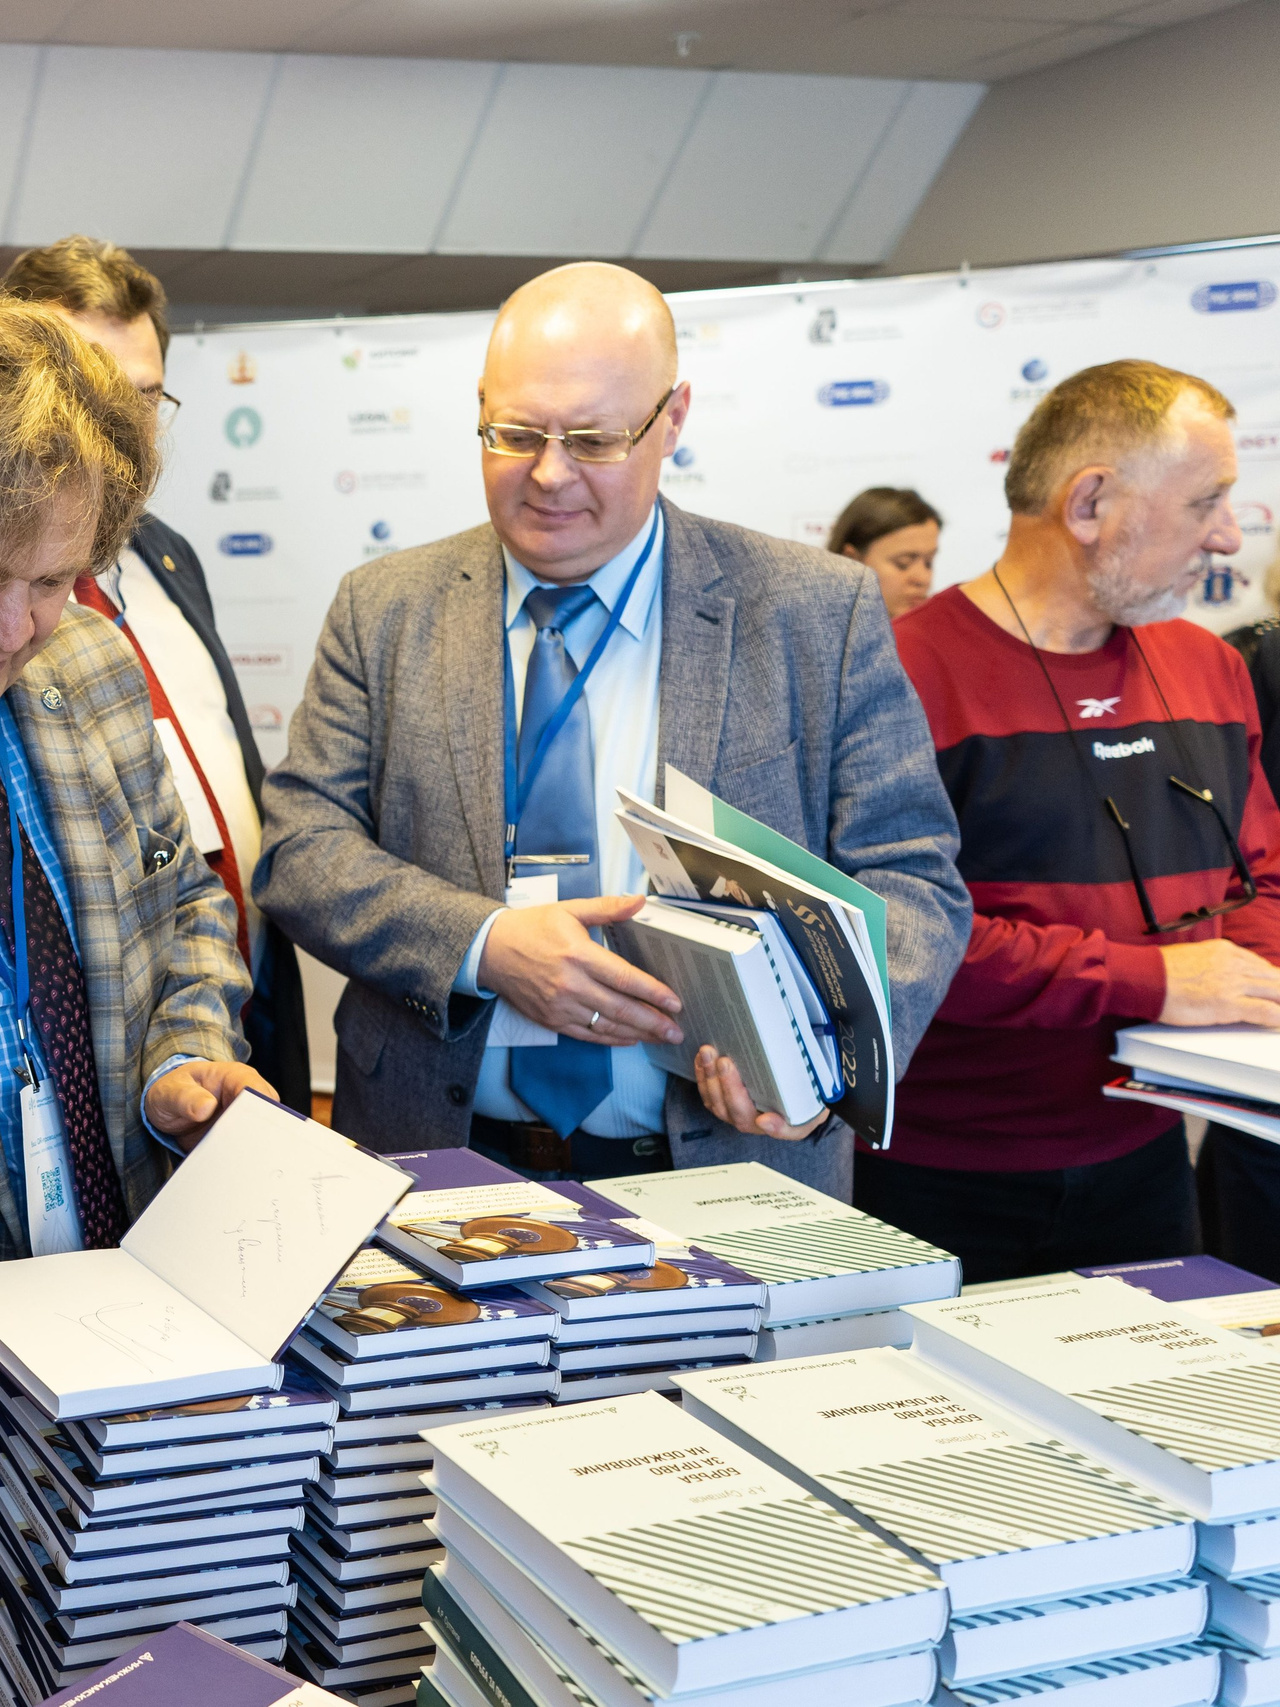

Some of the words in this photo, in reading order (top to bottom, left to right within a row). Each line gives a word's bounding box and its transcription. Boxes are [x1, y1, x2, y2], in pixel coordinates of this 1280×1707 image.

[837, 1019, 858, 1090] 2022
[1158, 1320, 1181, 1330] НА
[1054, 1322, 1159, 1344] ОБЖАЛОВАНИЕ
[1132, 1330, 1176, 1344] ПРАВО
[1177, 1328, 1200, 1337] ЗА
[1158, 1337, 1218, 1350] БОРЬБА
[707, 1361, 845, 1384] НИЖНЕКАМСКНЕФТЕХИМ
[927, 1394, 951, 1406] НА
[817, 1396, 928, 1419] ОБЖАЛОВАНИЕ
[895, 1406, 945, 1420] ПРАВО
[943, 1403, 967, 1413] ЗА
[458, 1409, 605, 1439] НИЖНЕКАМСКНЕФТЕХИМ
[921, 1413, 983, 1428] БОРЬБА
[685, 1446, 710, 1460] НА
[569, 1449, 686, 1477] ОБЖАЛОВАНИЕ
[649, 1459, 703, 1476] ПРАВО
[701, 1456, 726, 1469] ЗА
[677, 1467, 741, 1484] БОРЬБА
